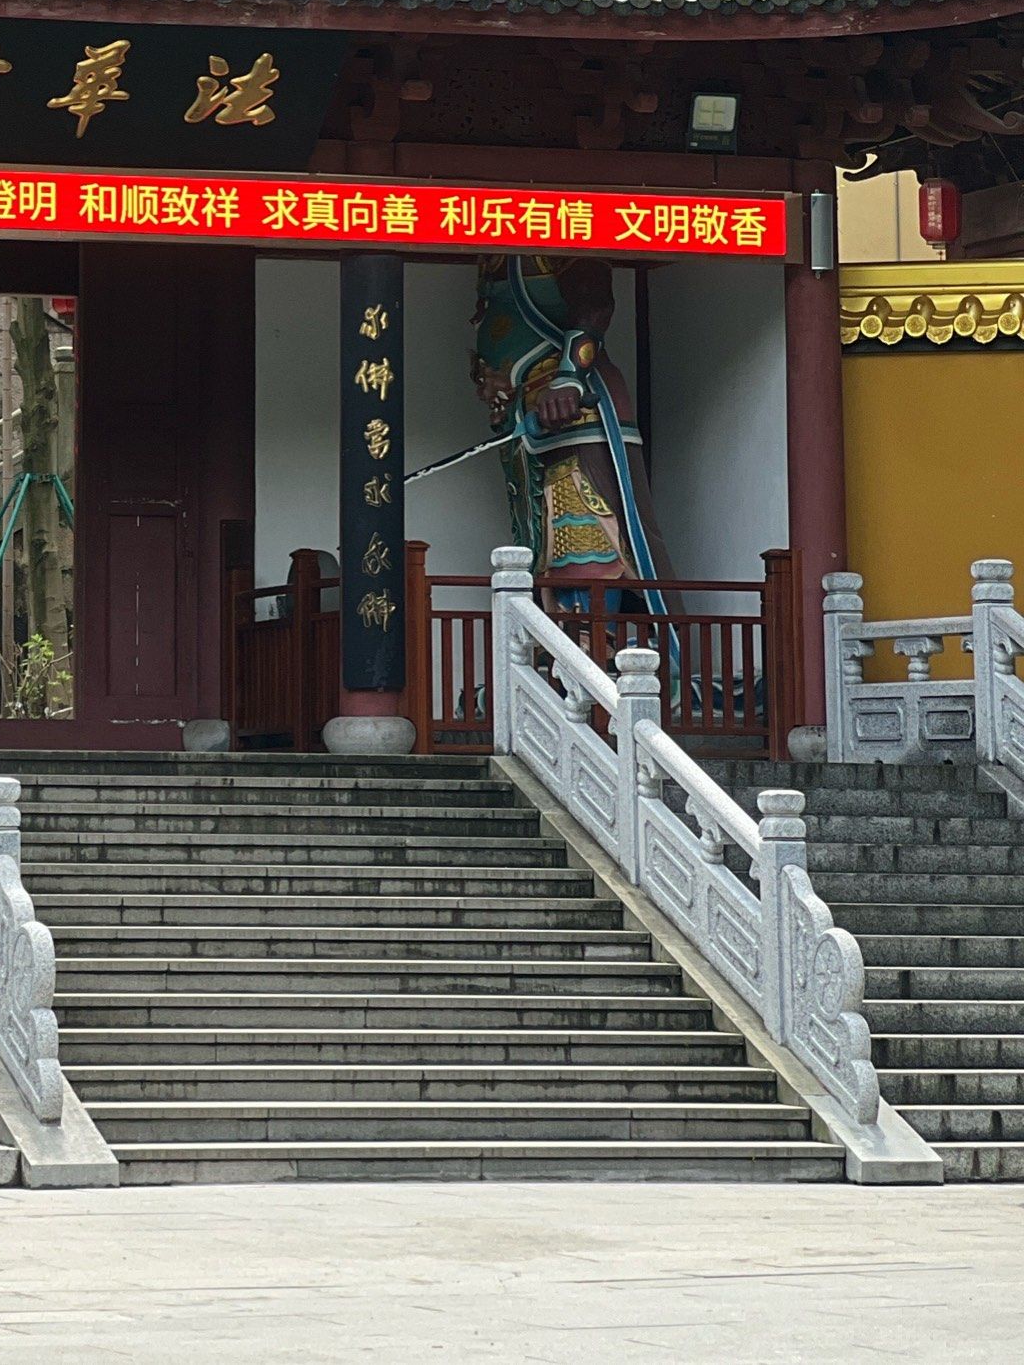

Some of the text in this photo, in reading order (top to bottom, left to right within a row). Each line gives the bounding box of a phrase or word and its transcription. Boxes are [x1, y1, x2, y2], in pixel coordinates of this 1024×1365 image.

[79, 183, 240, 228] 和顺致祥
[262, 188, 419, 234] 求真向善
[440, 195, 594, 240] 利乐有情
[615, 201, 767, 247] 文明敬香
